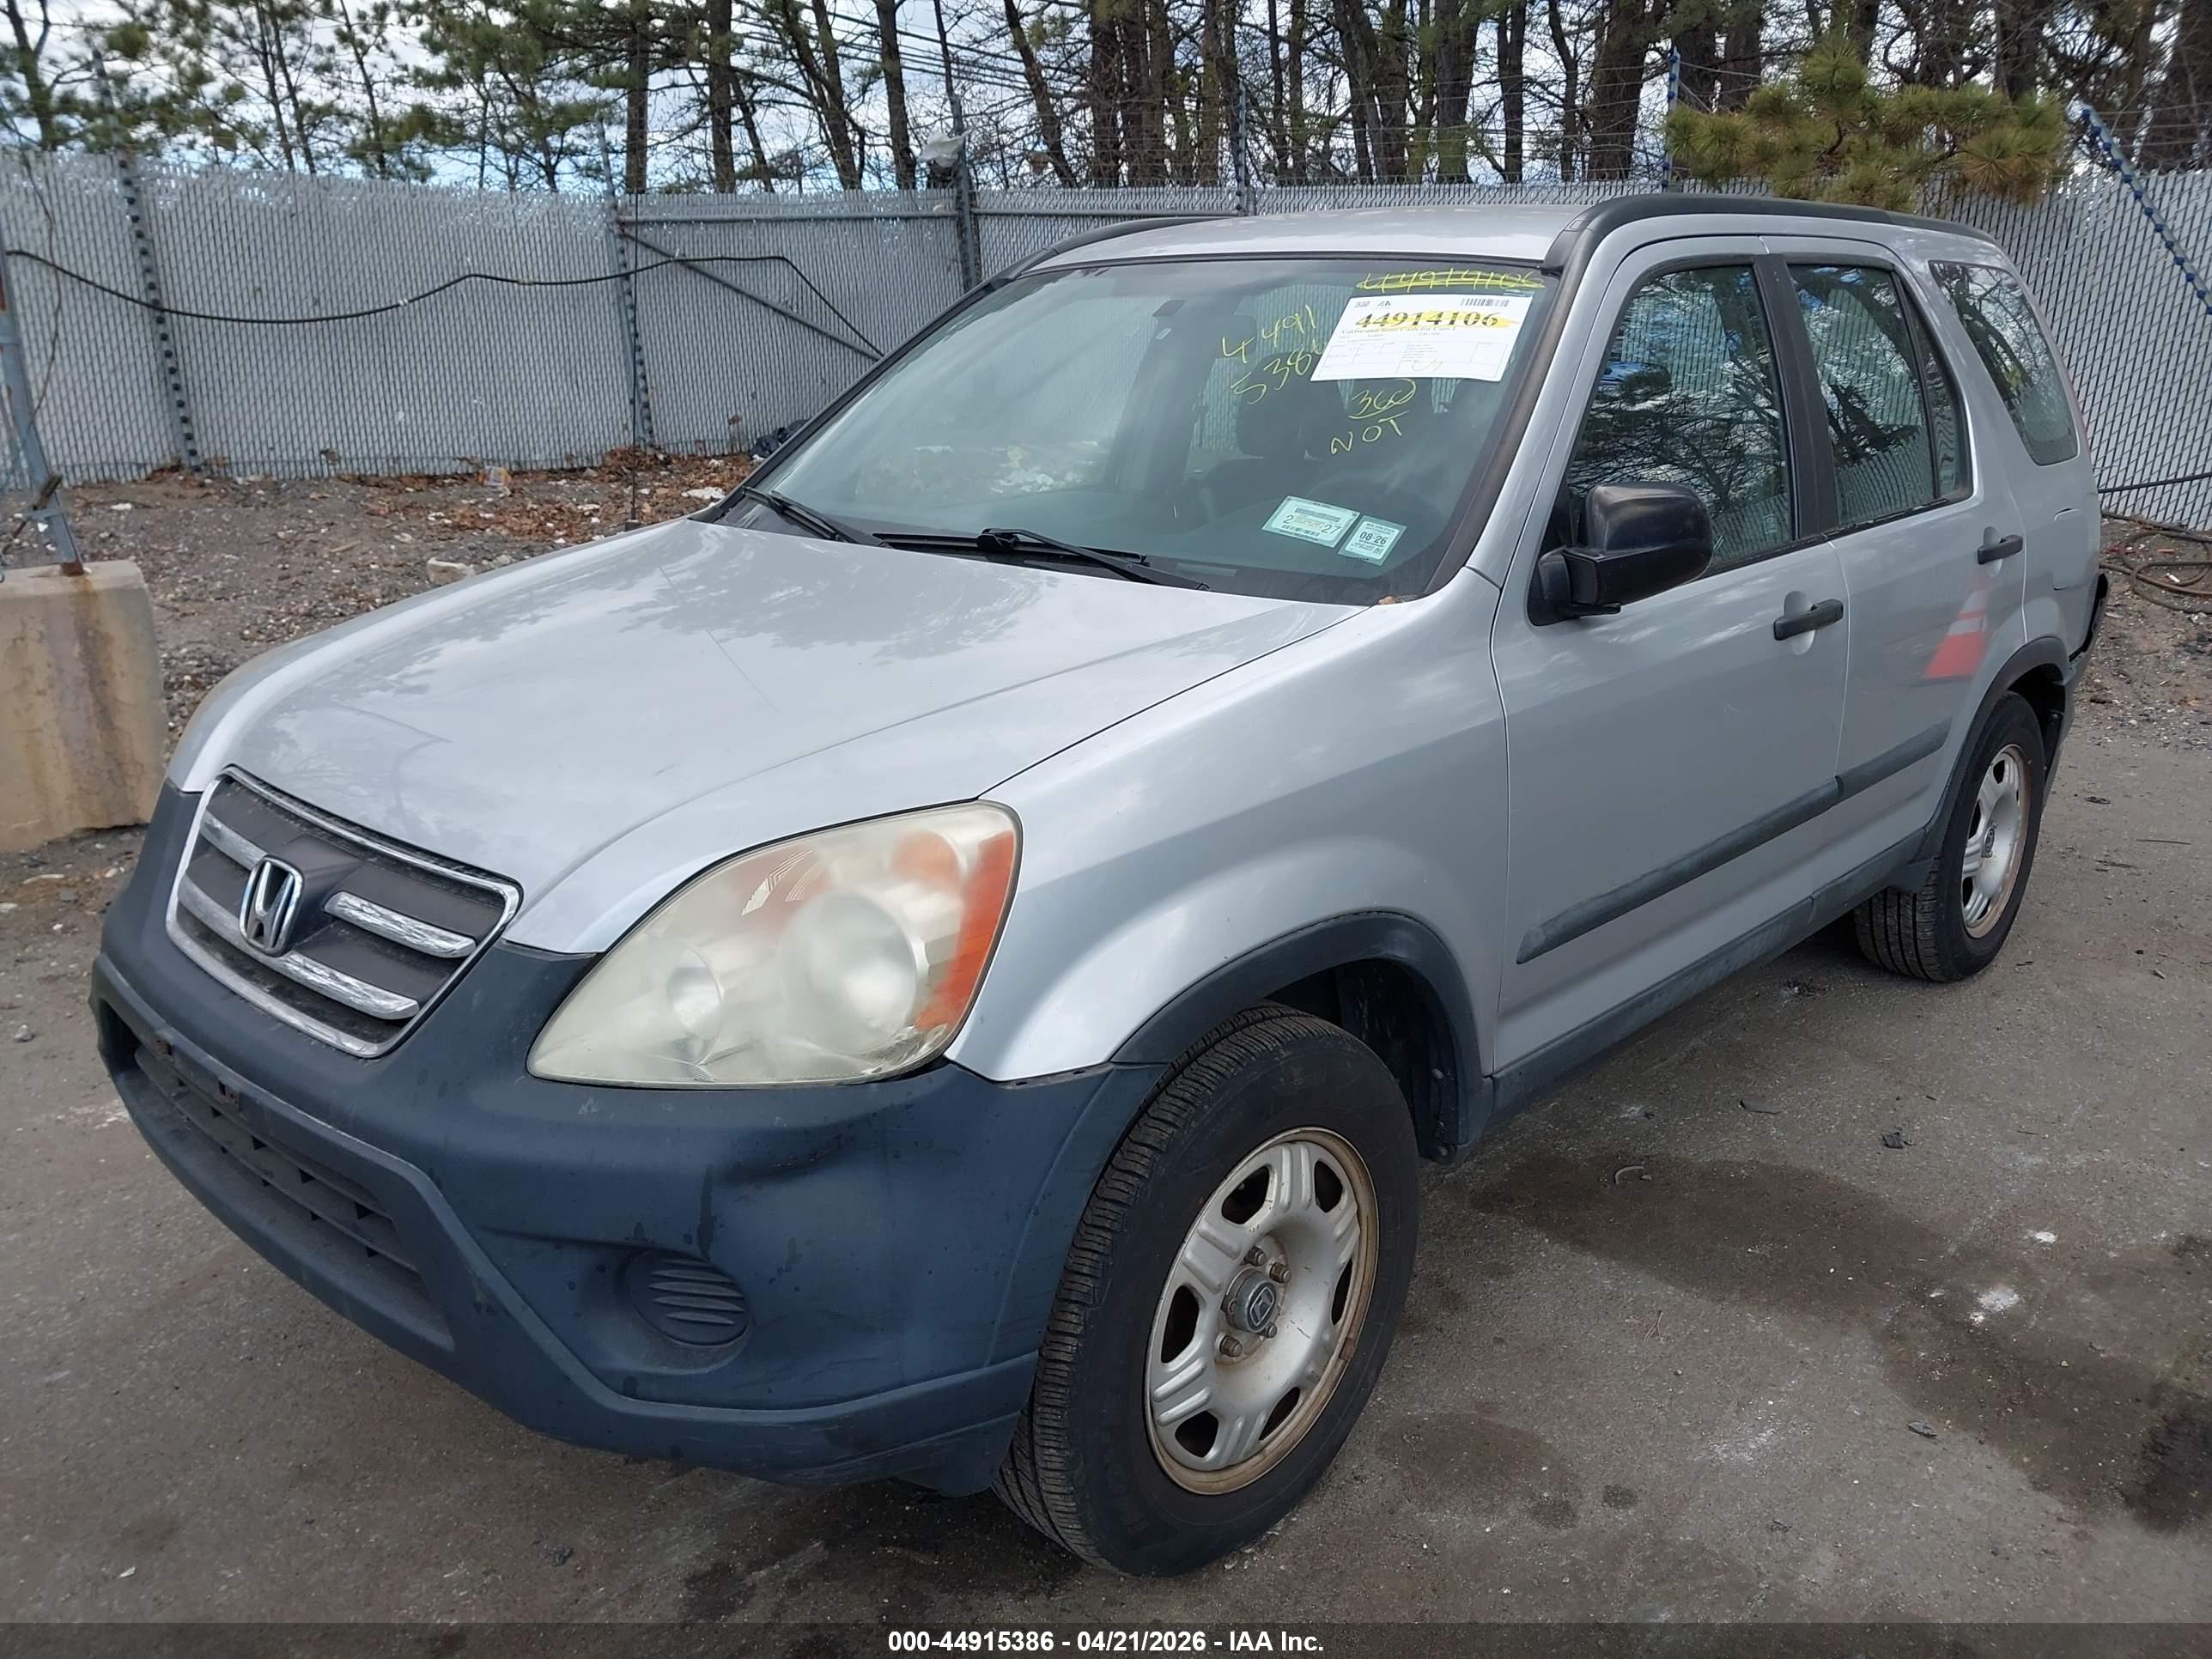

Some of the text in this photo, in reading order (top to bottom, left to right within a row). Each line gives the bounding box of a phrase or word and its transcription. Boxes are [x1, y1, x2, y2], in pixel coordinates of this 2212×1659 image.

[1355, 311, 1499, 328] 44914106
[1222, 304, 1316, 364] 4491
[1330, 410, 1409, 455] NOT
[1283, 514, 1294, 524] 2
[1321, 524, 1342, 535] 27
